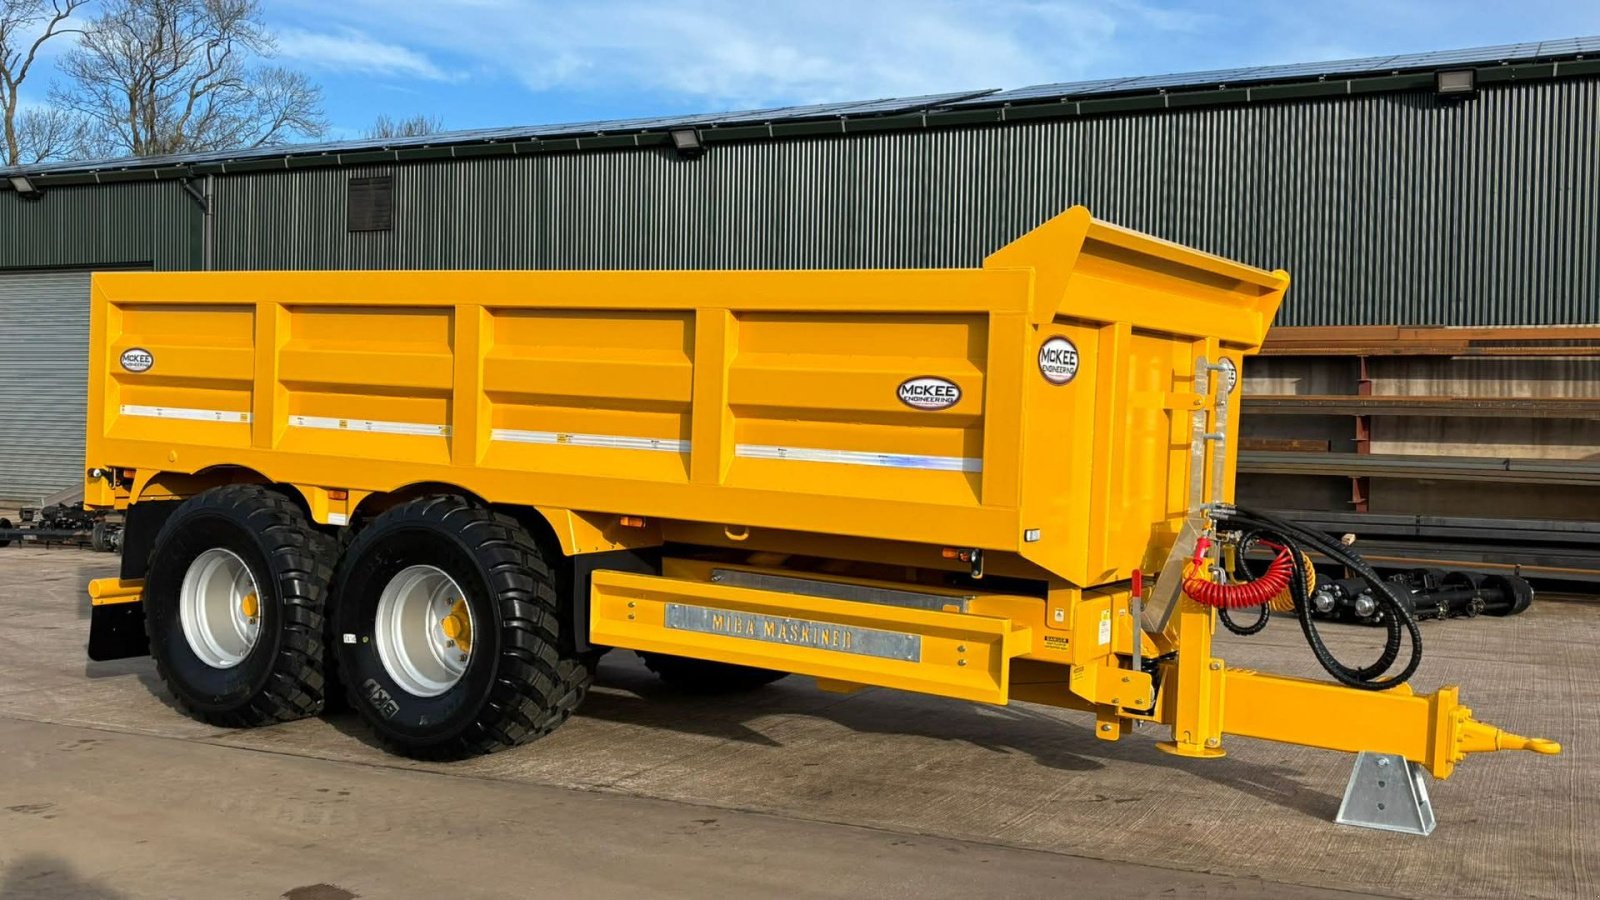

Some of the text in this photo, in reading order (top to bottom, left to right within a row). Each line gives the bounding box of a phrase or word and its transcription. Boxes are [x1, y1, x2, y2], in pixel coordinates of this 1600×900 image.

[1042, 365, 1074, 374] ENGINEERING
[903, 396, 954, 404] ENGINEERING
[712, 613, 852, 649] MIBA MASKINER
